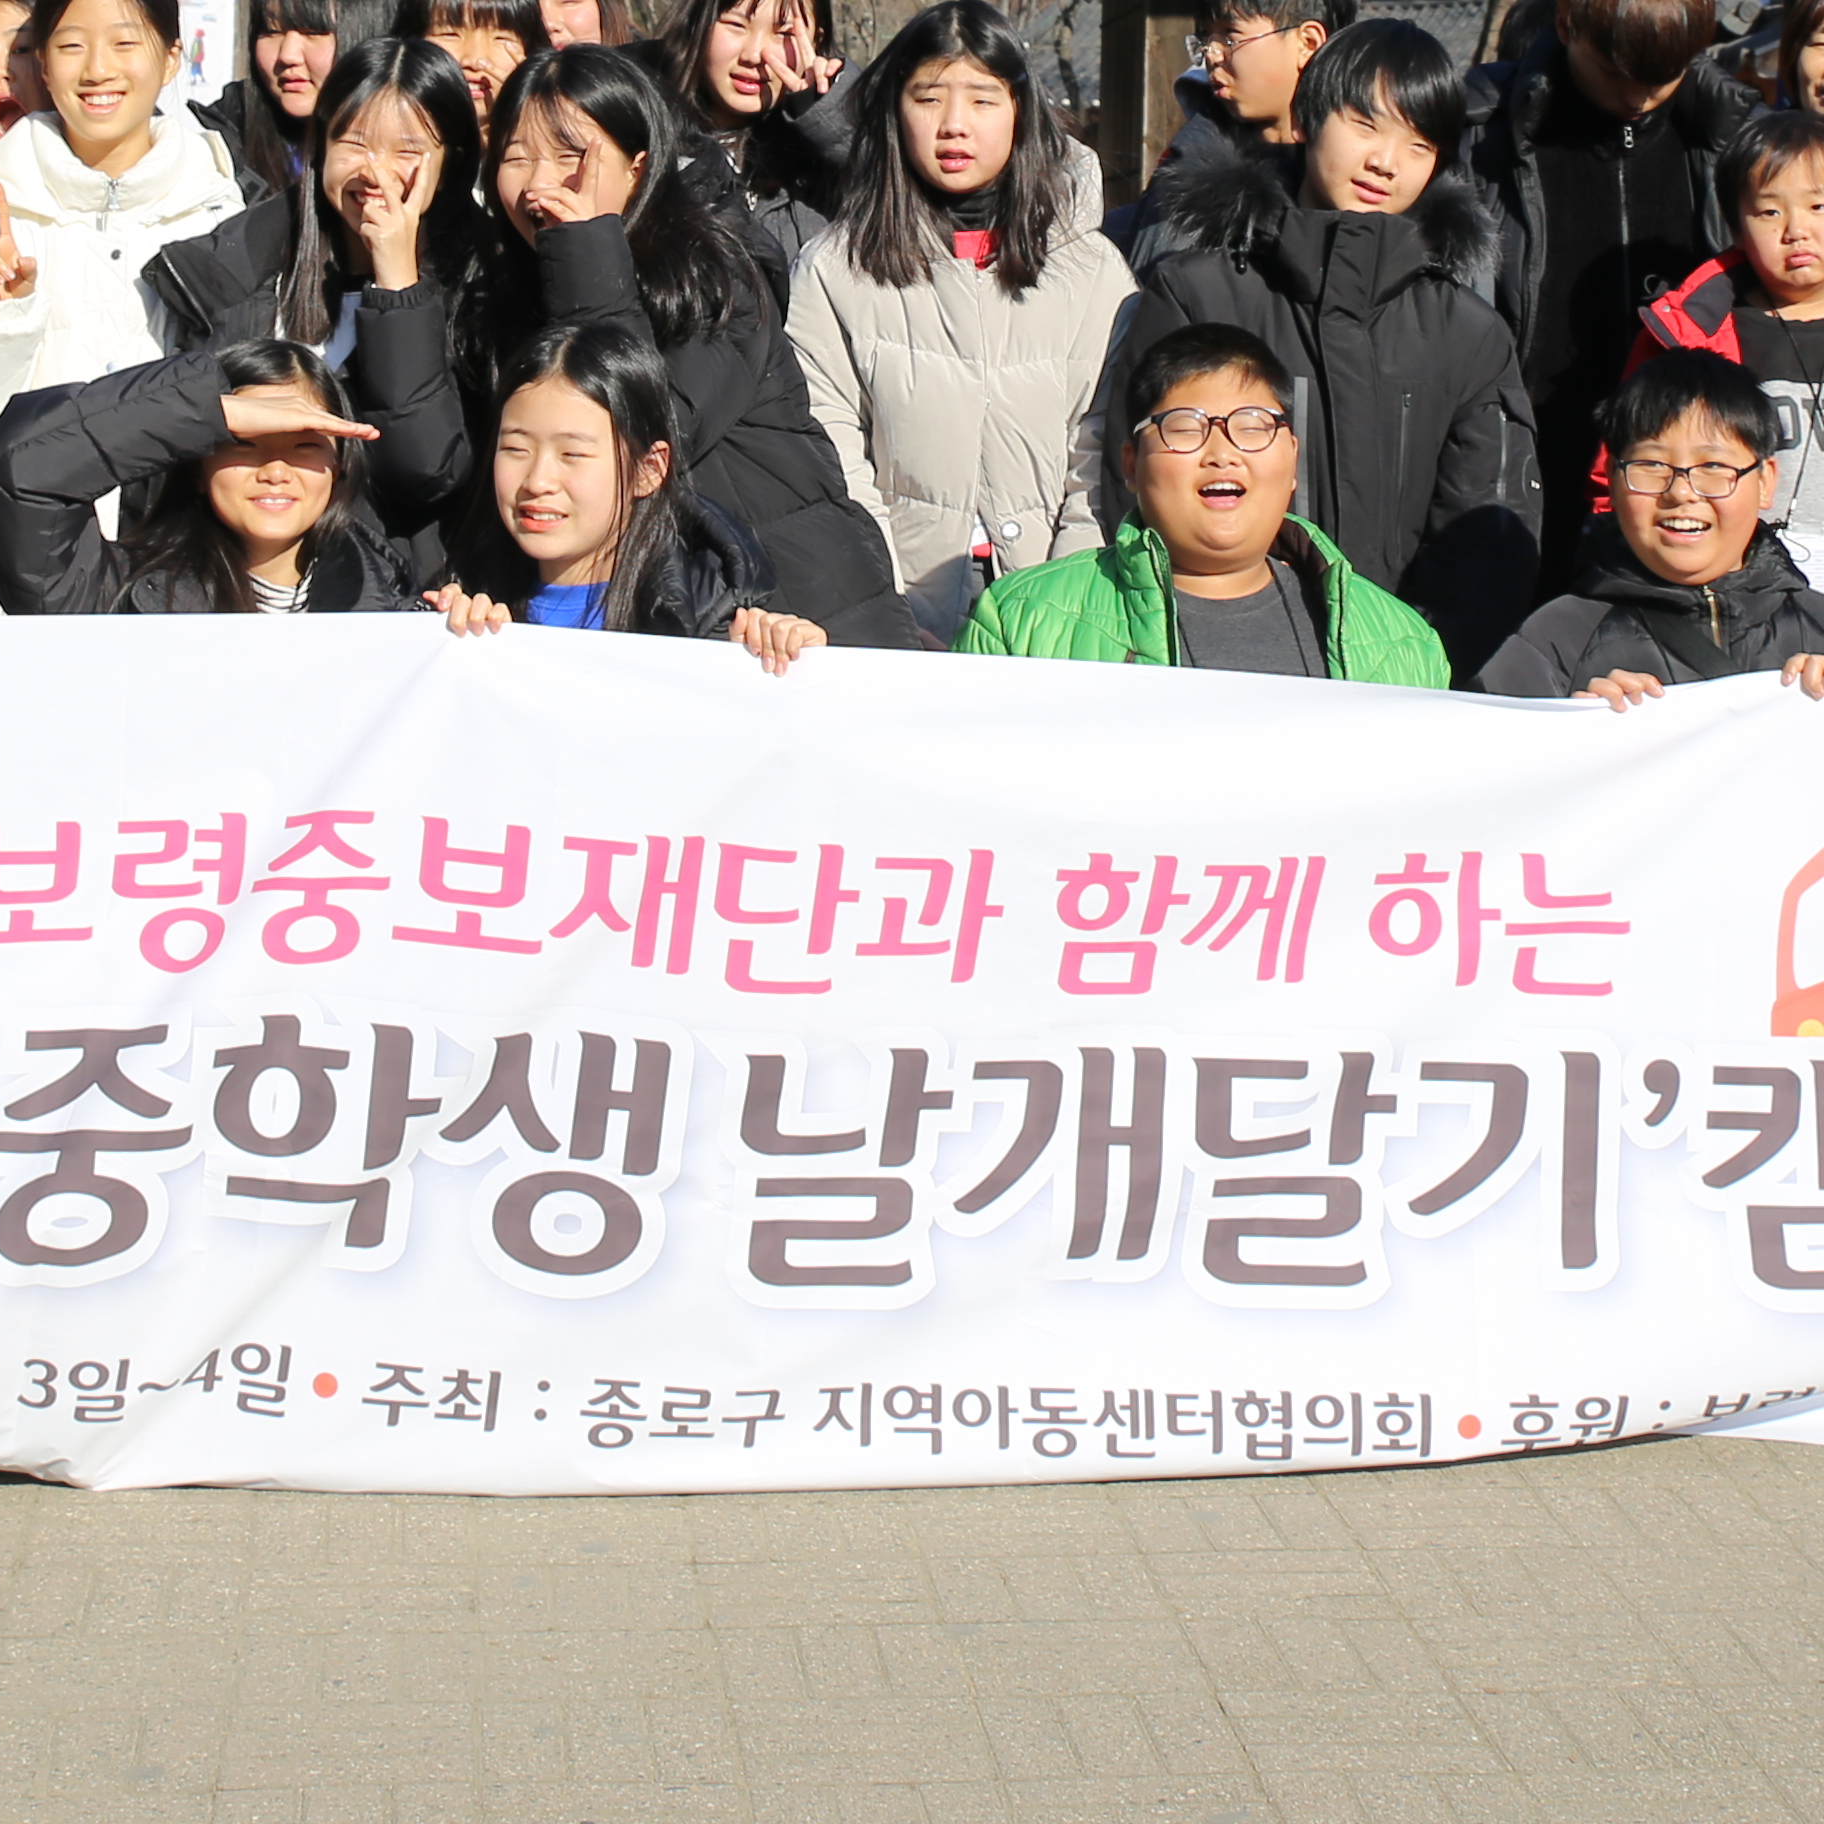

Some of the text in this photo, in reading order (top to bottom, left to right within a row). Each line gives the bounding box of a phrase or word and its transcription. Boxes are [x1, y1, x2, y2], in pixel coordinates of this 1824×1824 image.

[1056, 852, 1326, 996] 함께
[1369, 851, 1630, 997] 하는
[361, 1362, 502, 1432] 주최
[579, 1378, 785, 1449] 종로구
[813, 1382, 1432, 1461] 지역아동센터협의회
[1501, 1394, 1630, 1453] 후원
